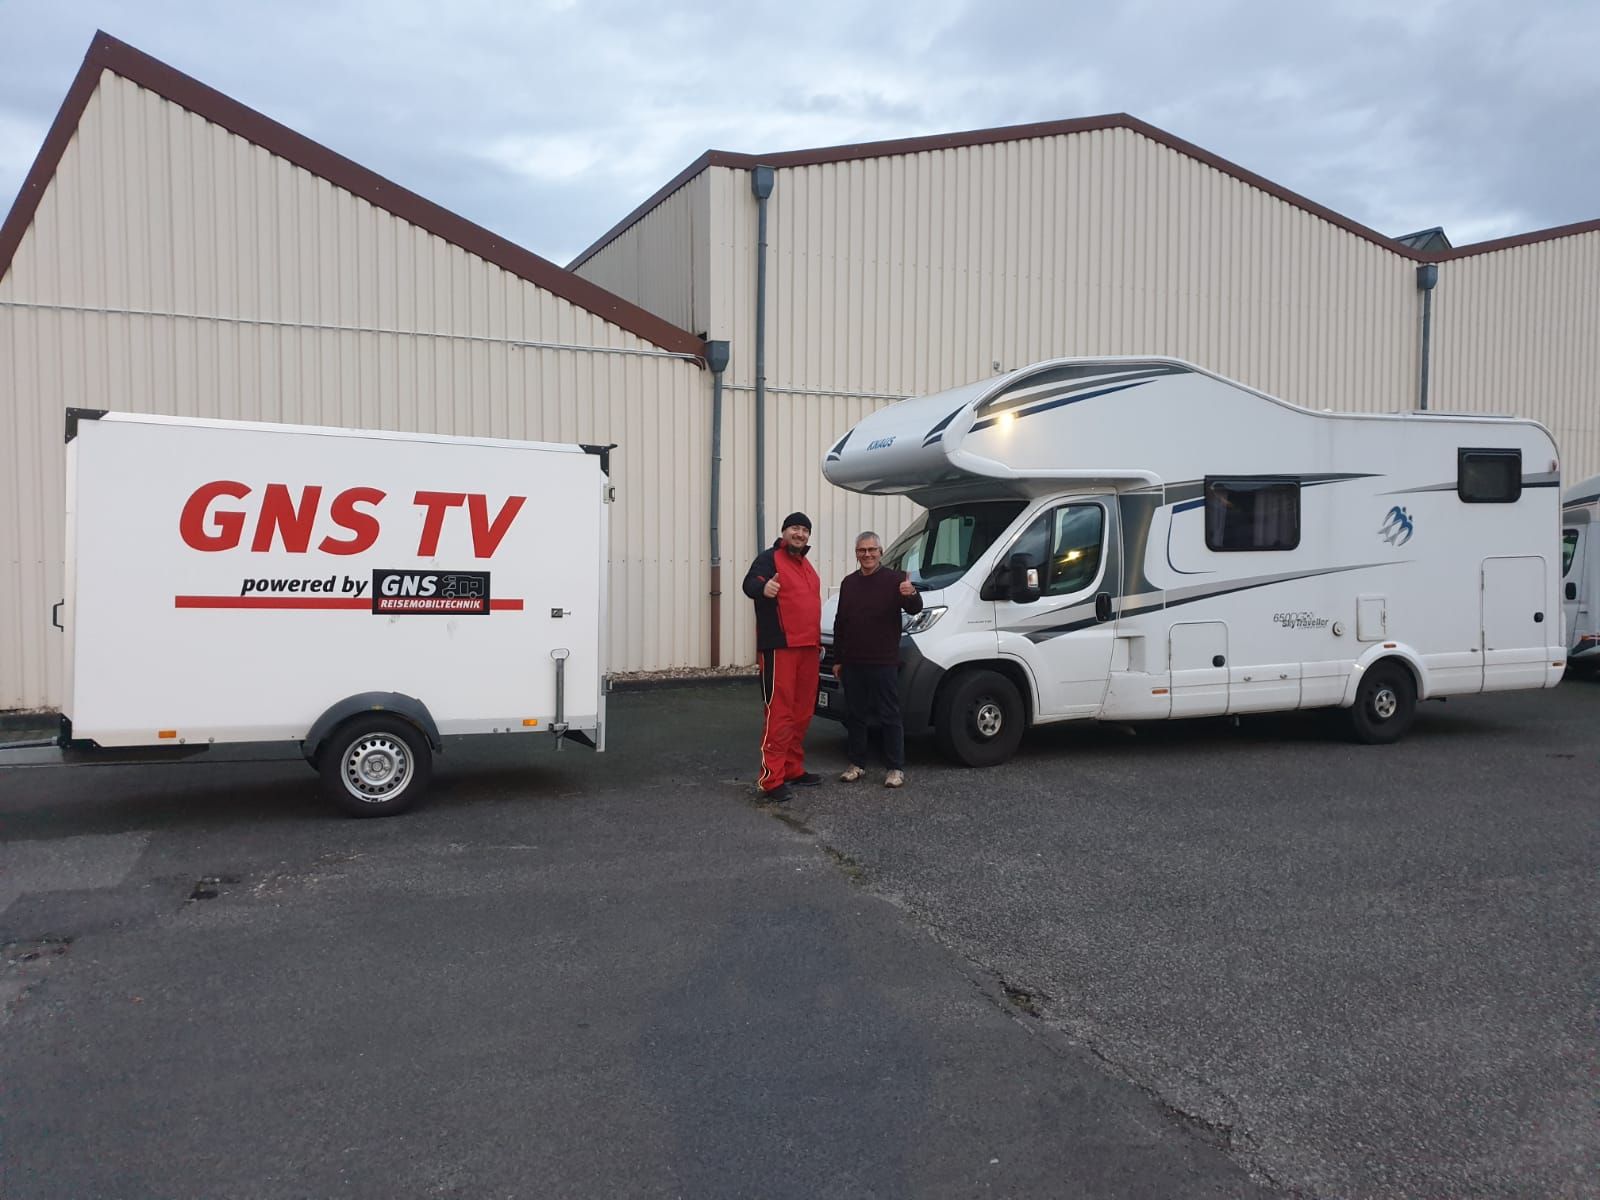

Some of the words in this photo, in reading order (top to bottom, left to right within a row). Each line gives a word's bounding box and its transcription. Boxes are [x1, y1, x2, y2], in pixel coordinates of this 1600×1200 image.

[179, 480, 387, 555] GNS
[413, 490, 527, 559] TV
[240, 575, 335, 596] powered
[341, 576, 368, 598] by
[381, 574, 438, 597] GNS
[380, 599, 481, 609] REISEMOBILTECHNIK
